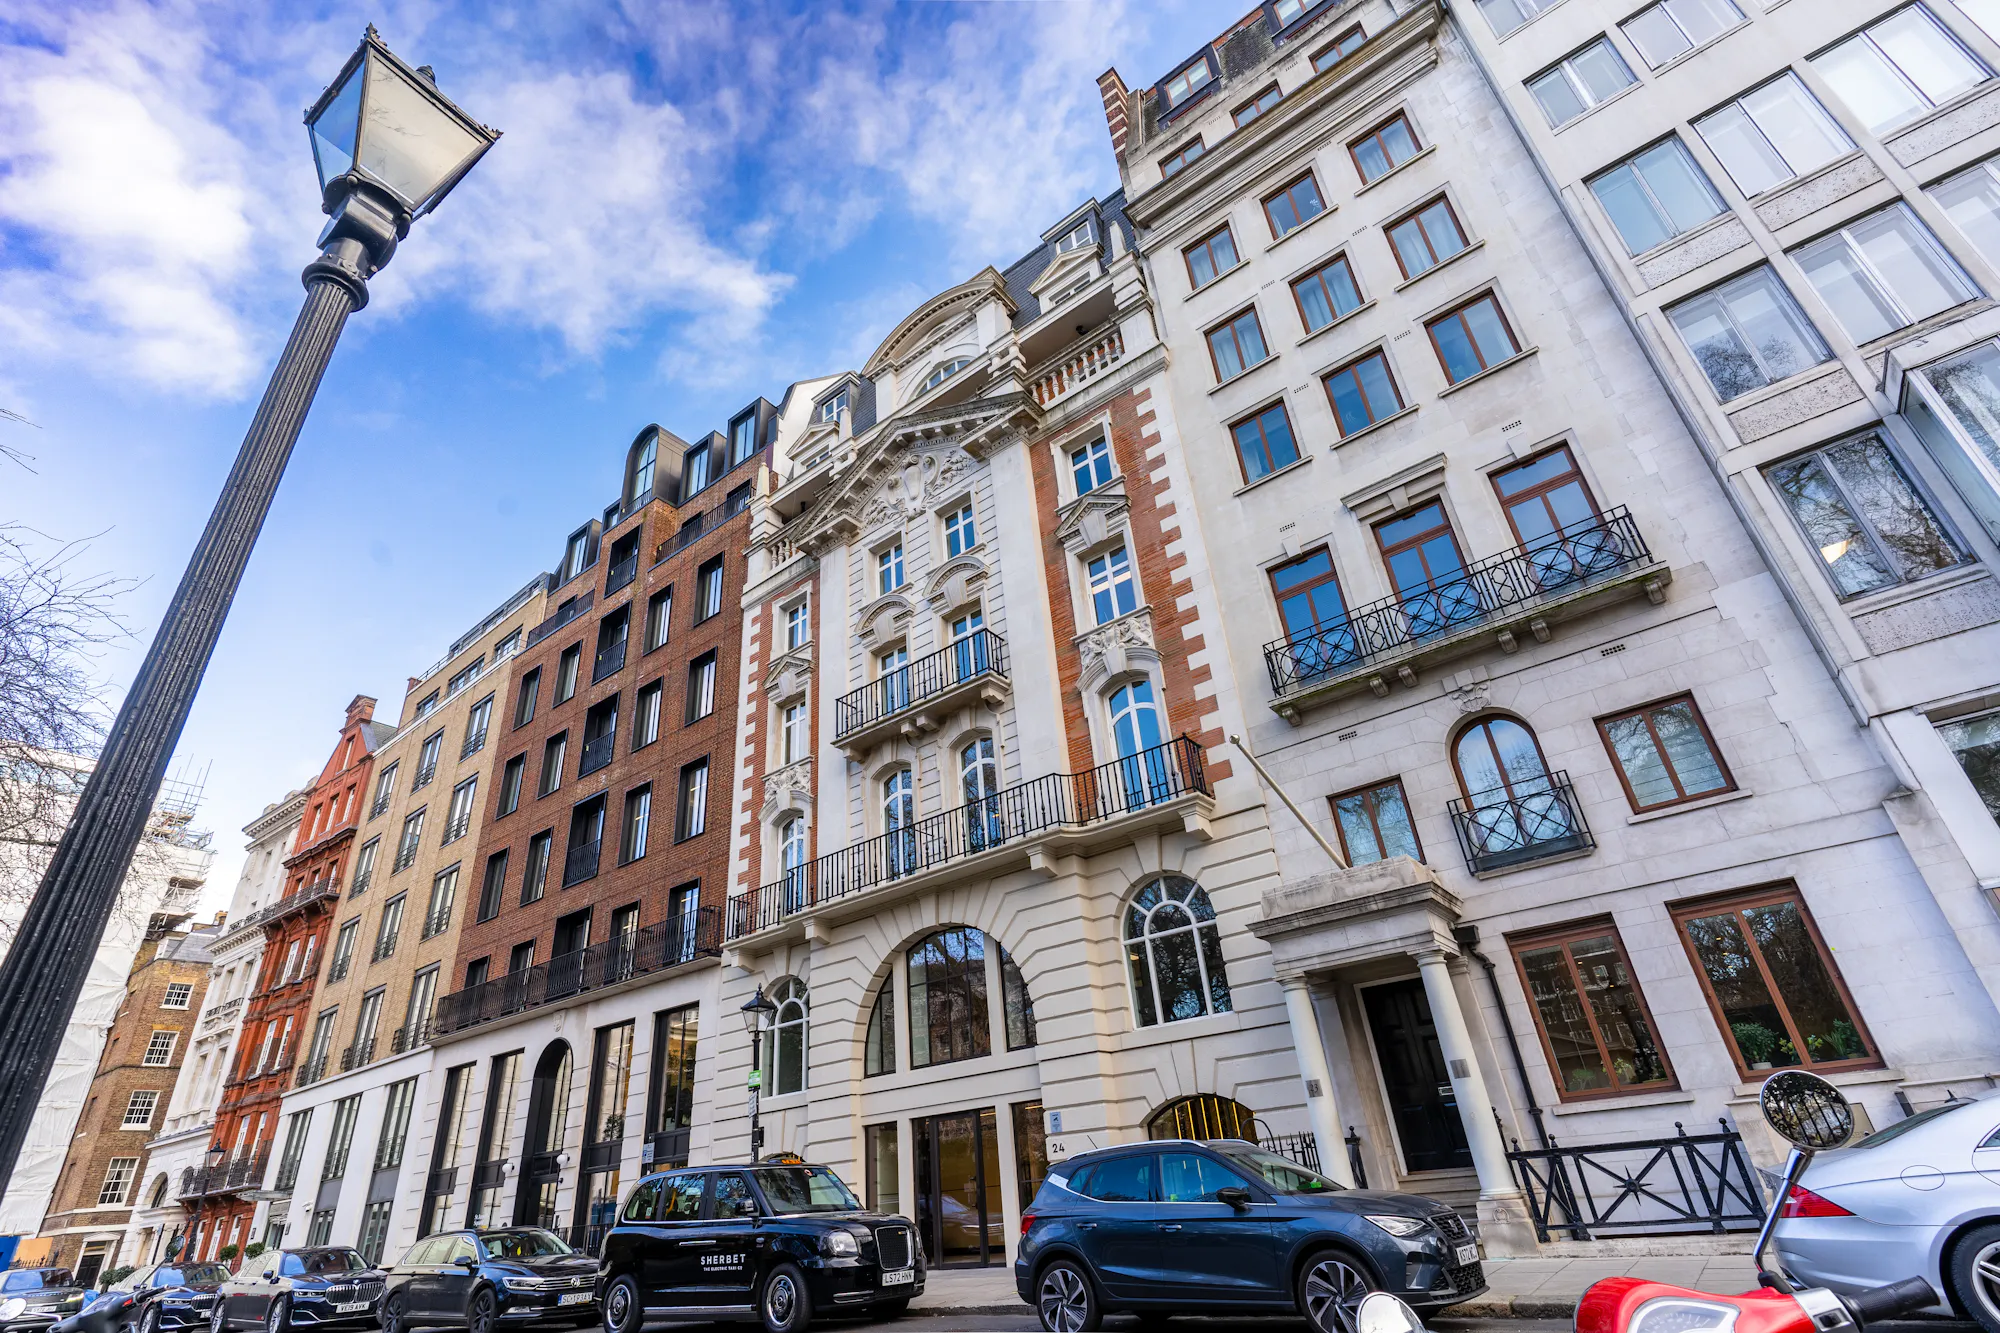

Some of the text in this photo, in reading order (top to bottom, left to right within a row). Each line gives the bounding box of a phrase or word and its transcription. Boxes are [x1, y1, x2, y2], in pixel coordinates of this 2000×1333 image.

[1310, 1083, 1319, 1094] 23
[1052, 1143, 1065, 1153] 24
[700, 1253, 746, 1265] SHERBET
[884, 1273, 901, 1283] LS72
